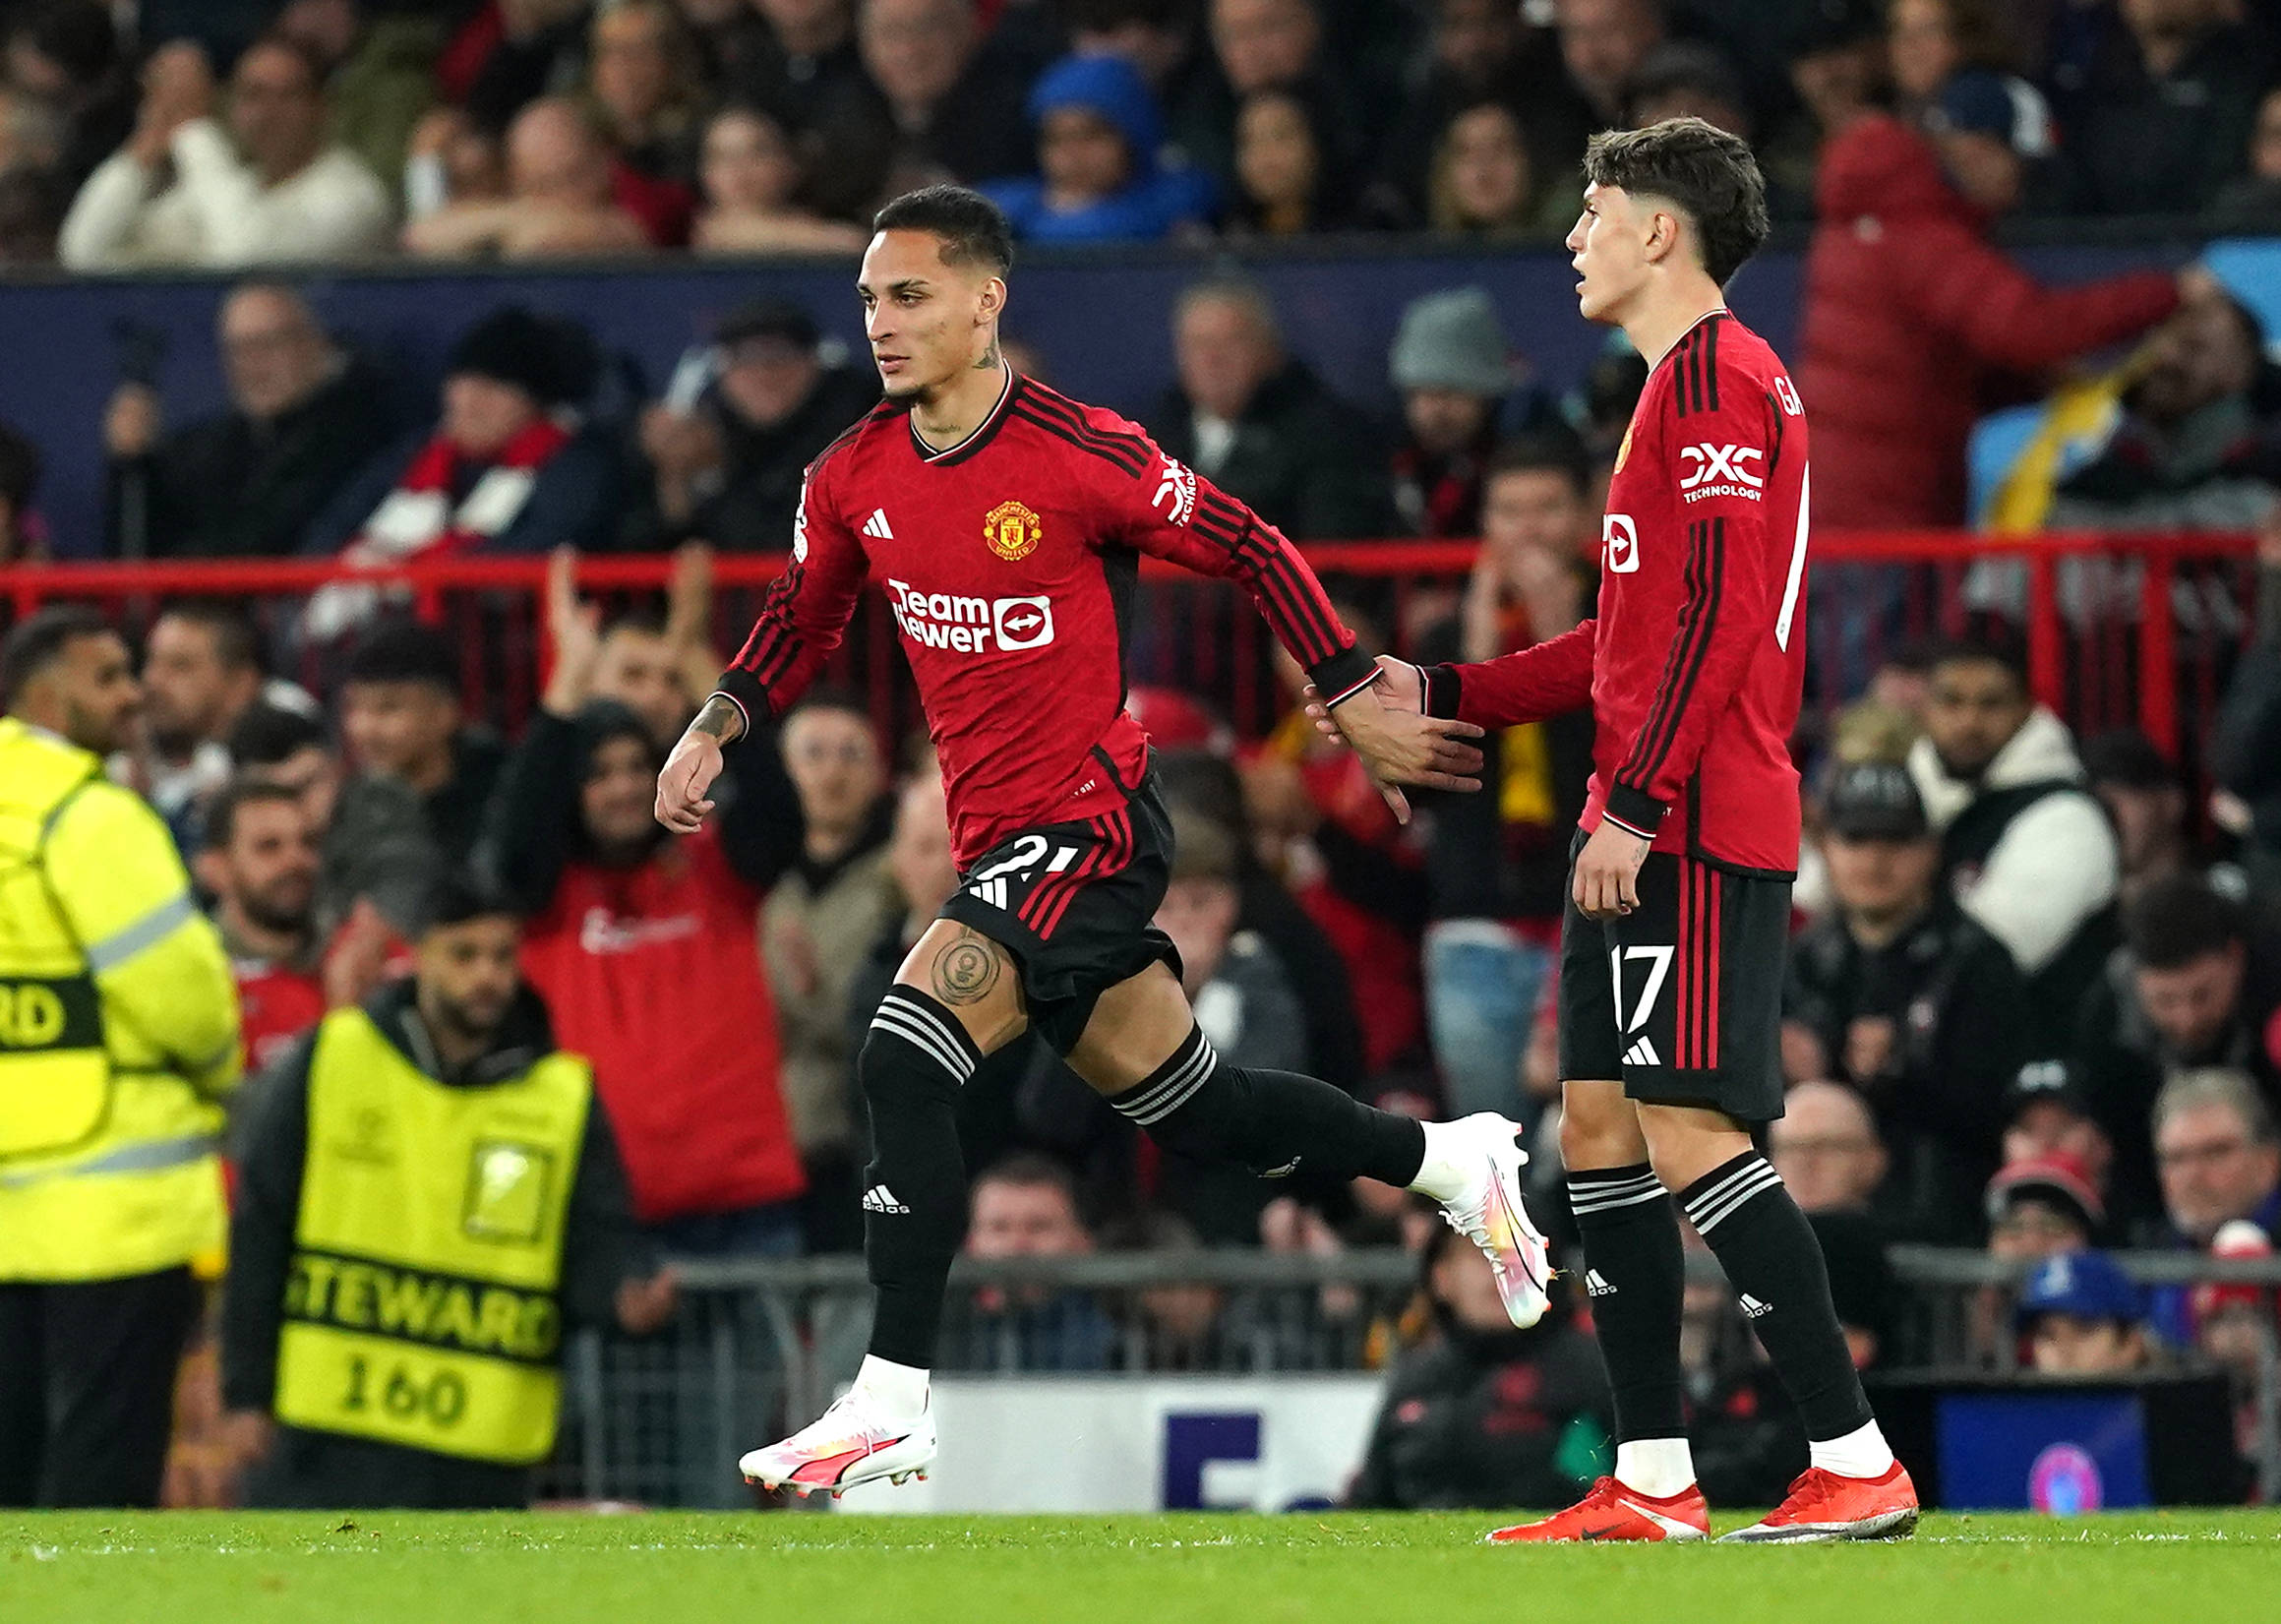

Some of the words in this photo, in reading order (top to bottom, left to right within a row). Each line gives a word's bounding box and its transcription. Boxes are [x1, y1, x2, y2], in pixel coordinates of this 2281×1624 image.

[1680, 443, 1763, 489] DXC
[1683, 485, 1762, 504] TECHNOLOGY
[888, 578, 990, 624] Team
[1611, 944, 1675, 1034] 17
[343, 1353, 468, 1431] 160
